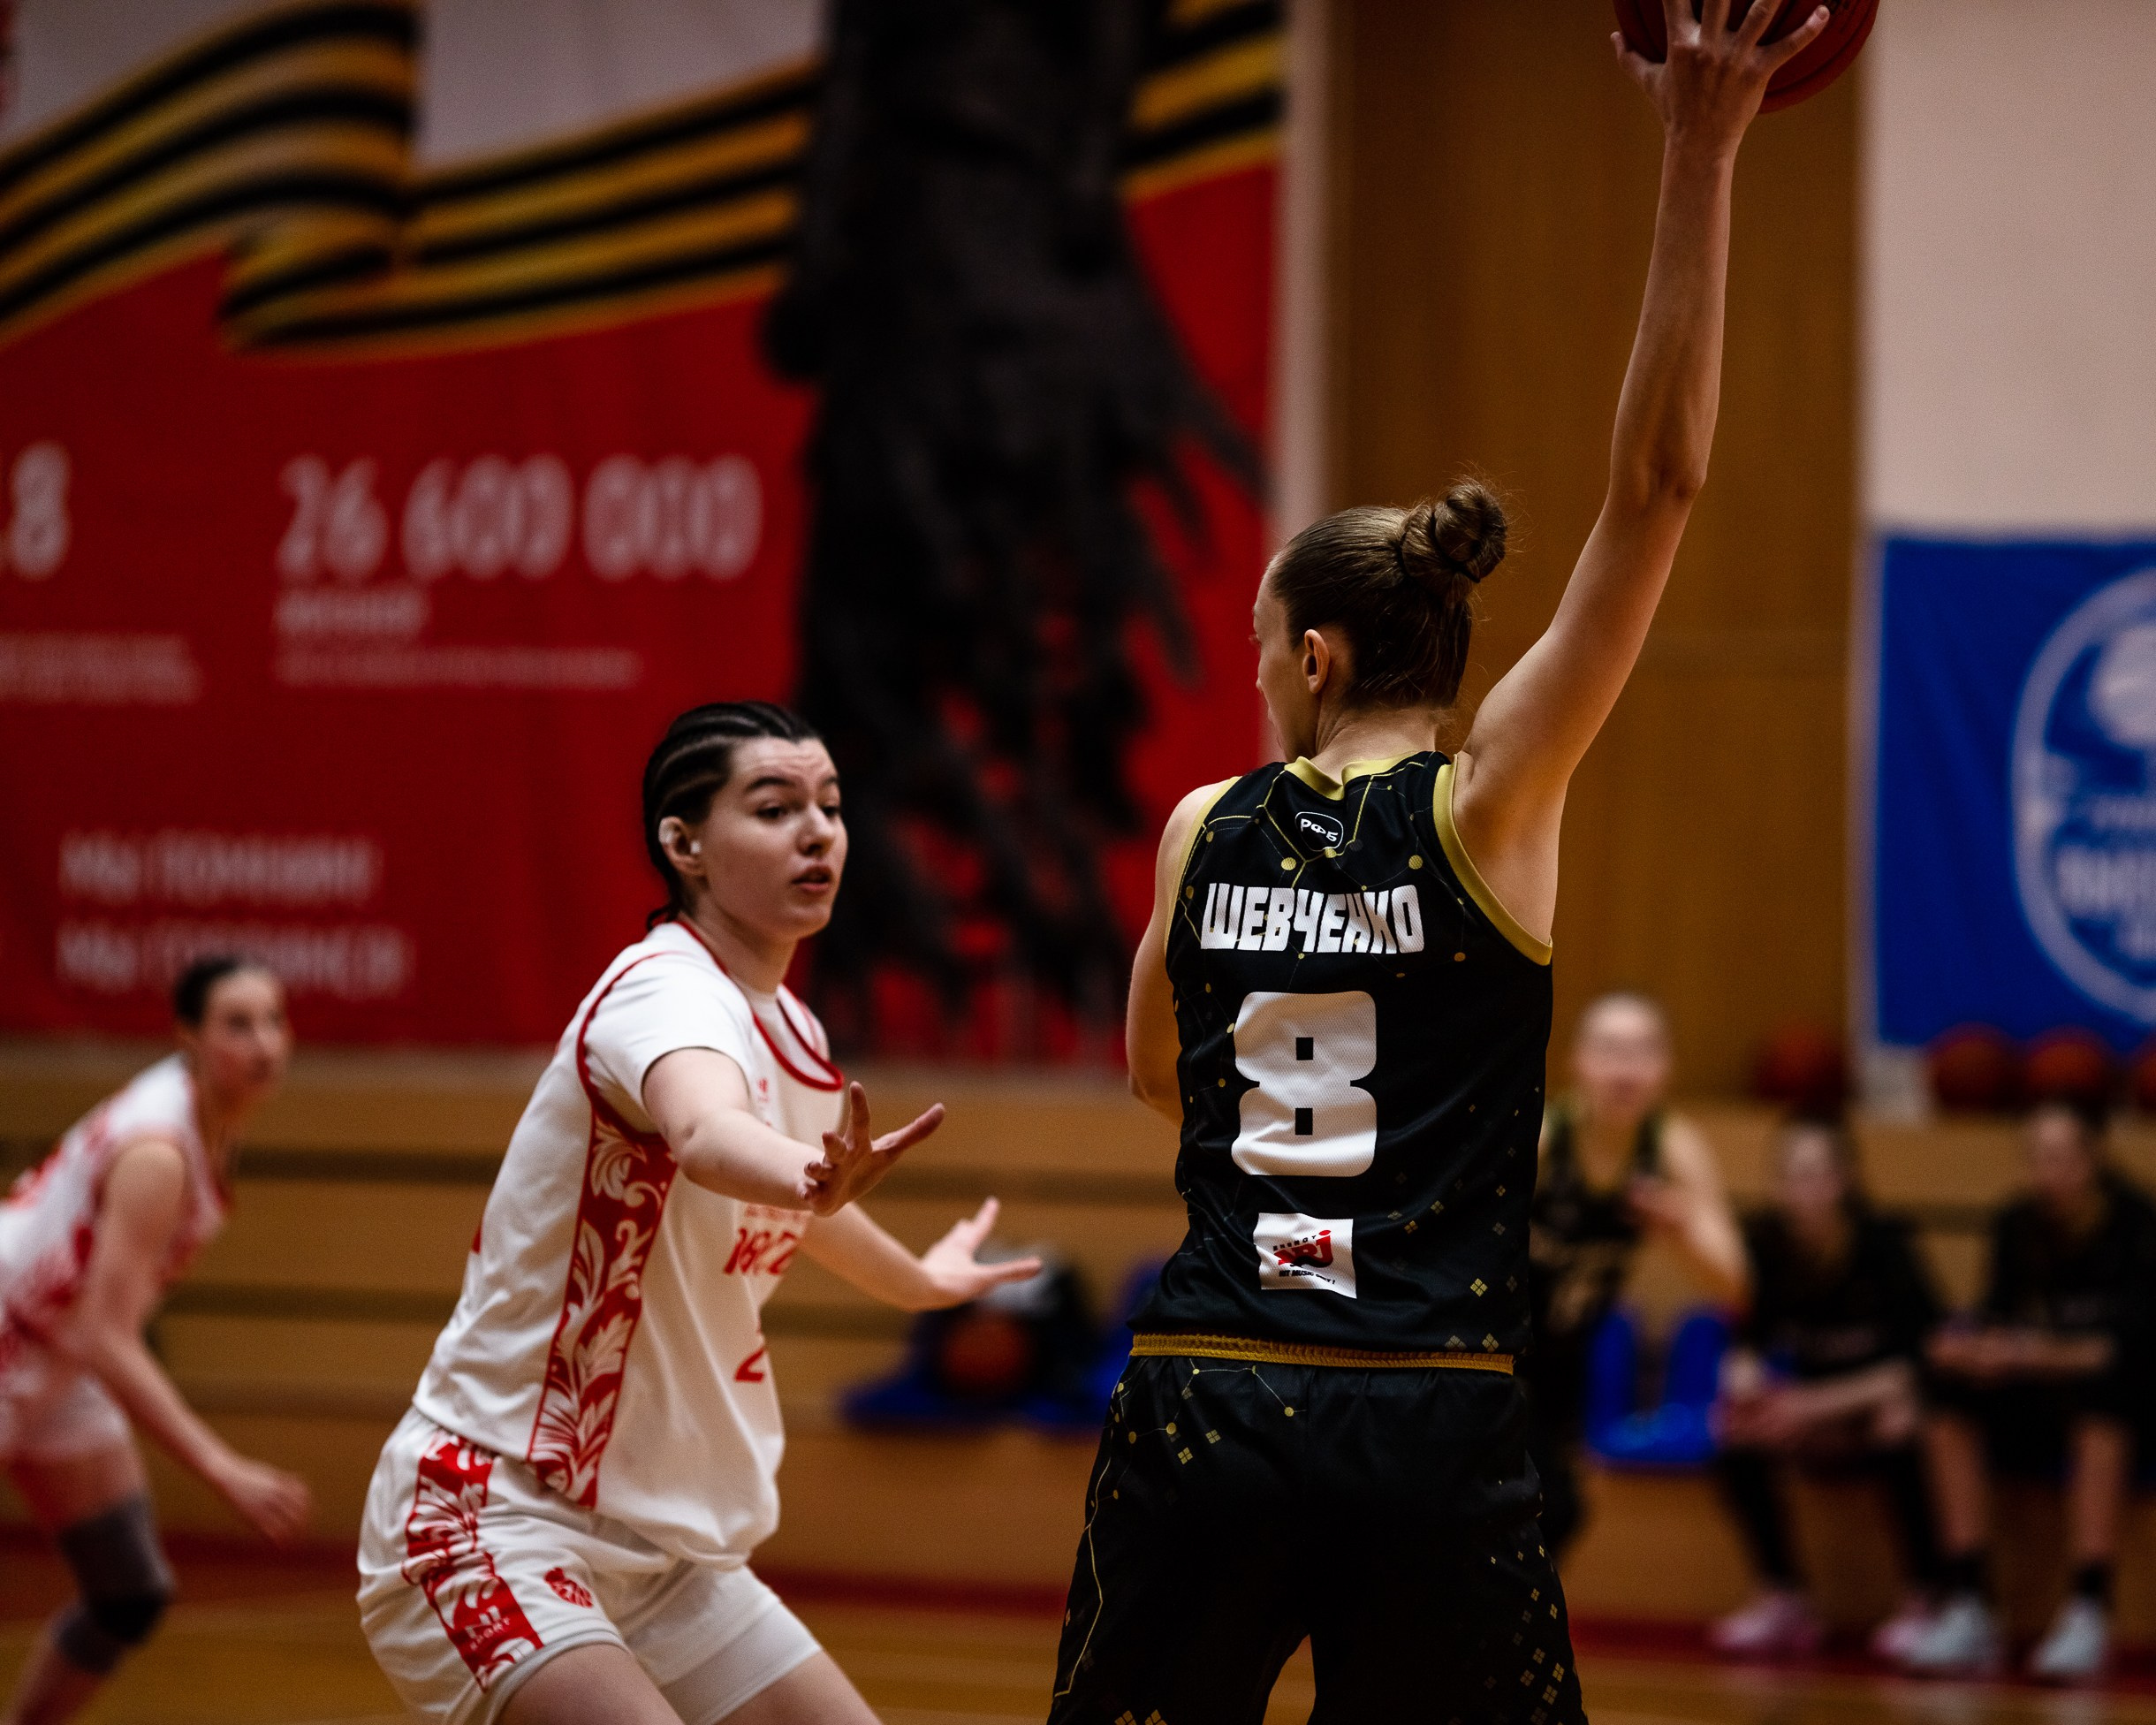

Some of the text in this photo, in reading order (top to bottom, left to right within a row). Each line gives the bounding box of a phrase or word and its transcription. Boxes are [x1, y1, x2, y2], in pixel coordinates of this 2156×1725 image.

[276, 453, 389, 581] 26
[1301, 818, 1339, 842] РФБ
[1201, 883, 1424, 954] ШЕВЧЕНКО
[1231, 991, 1378, 1177] 8
